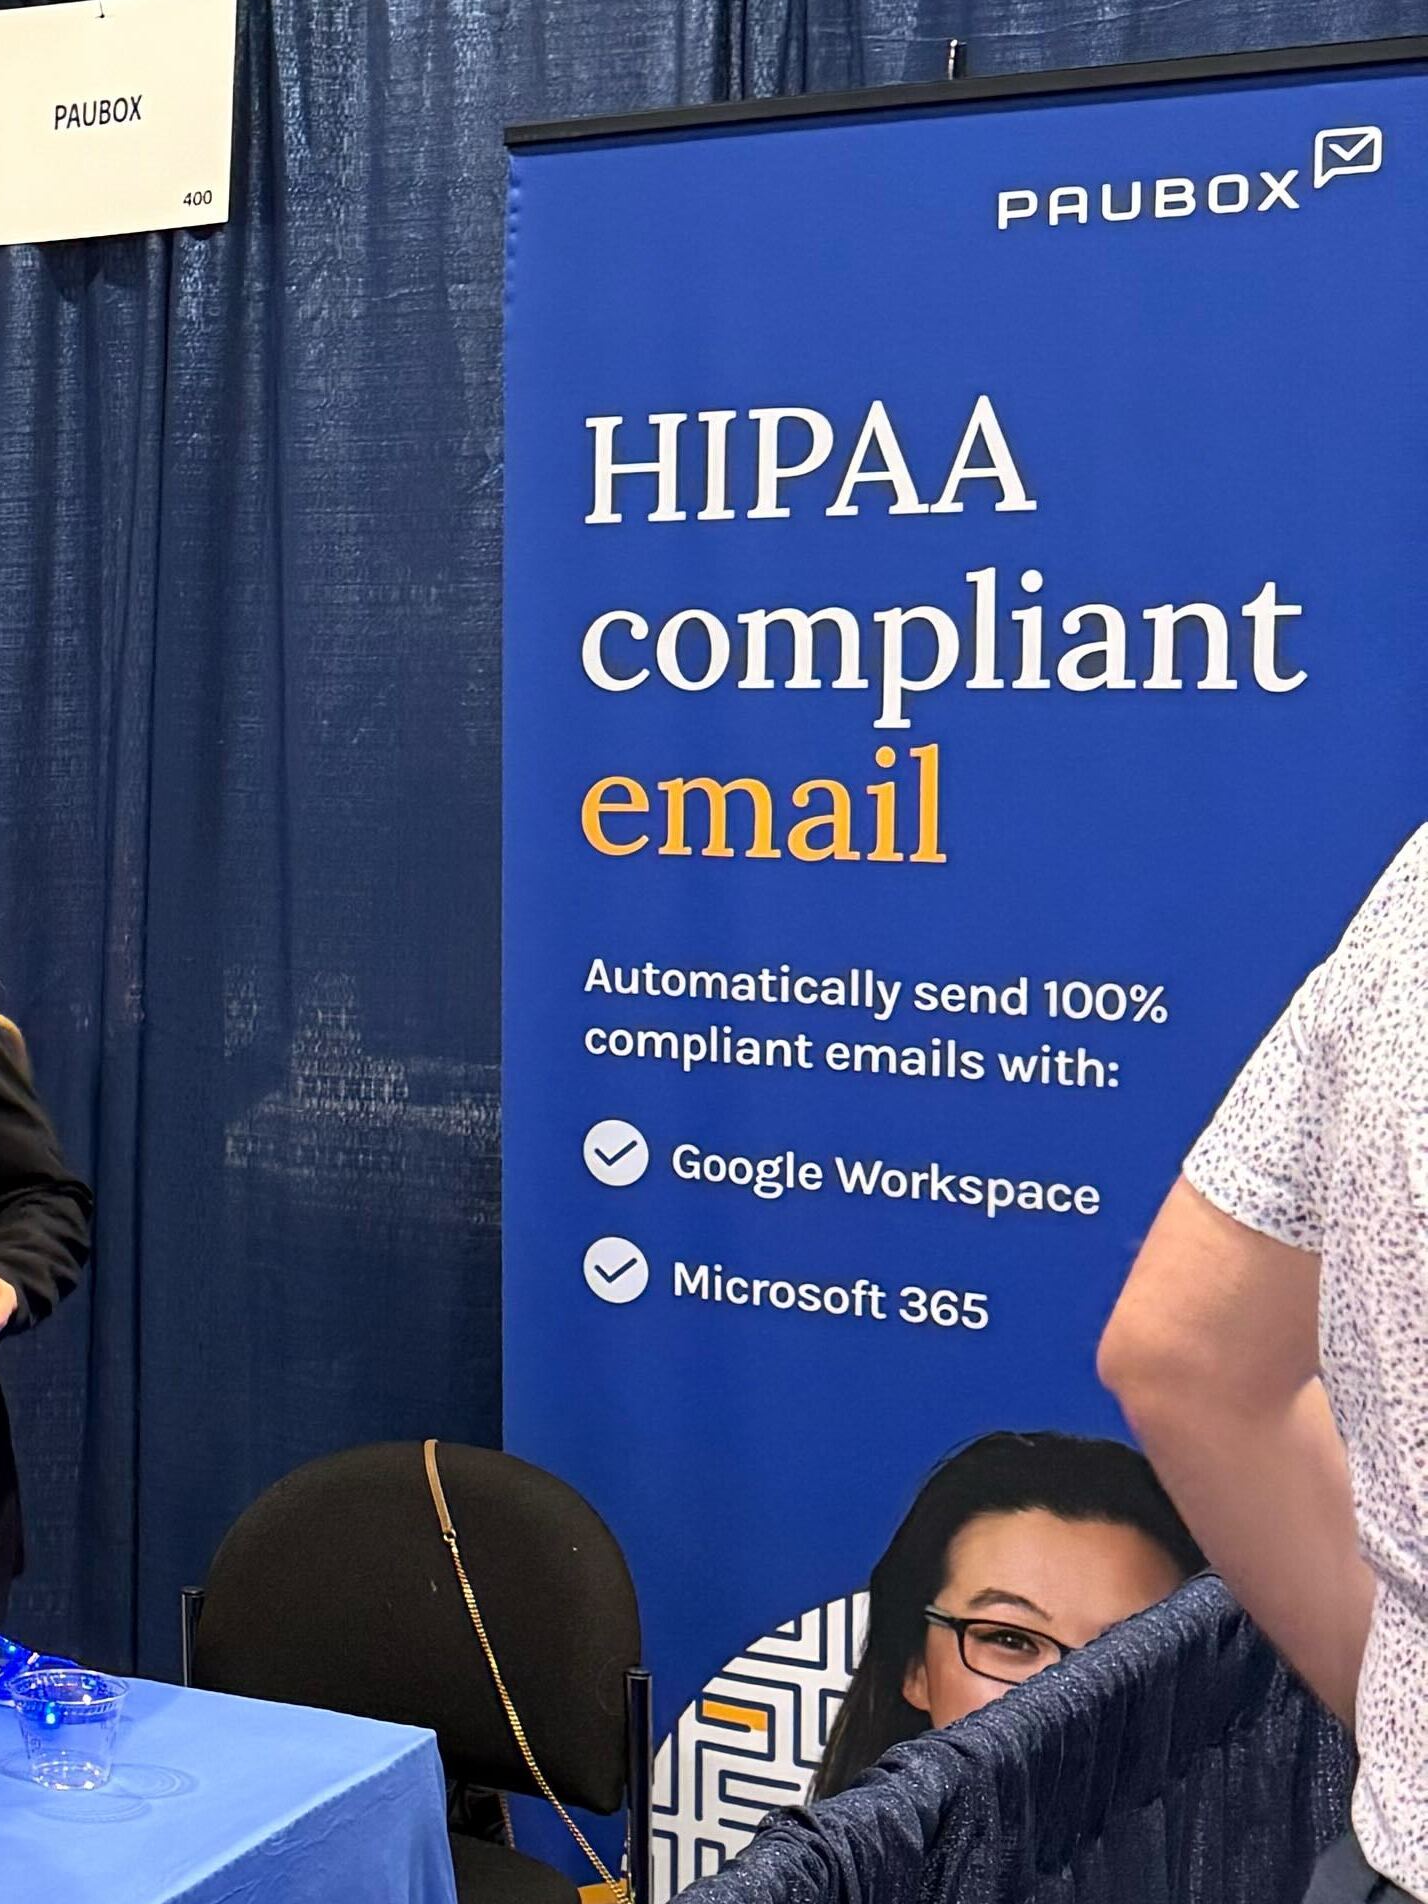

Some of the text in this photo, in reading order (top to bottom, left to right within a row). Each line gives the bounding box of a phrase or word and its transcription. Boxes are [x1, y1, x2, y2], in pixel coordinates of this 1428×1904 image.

[55, 95, 142, 130] PAUBOX
[182, 190, 213, 206] 400
[998, 170, 1299, 229] PAUBOX
[585, 395, 1037, 524] HIPAA
[582, 567, 1307, 728] compliant
[582, 744, 946, 863] email
[585, 959, 1167, 1023] Automatically send 100%
[585, 1026, 1118, 1087] compliant emails with:
[673, 1144, 1099, 1217] Google Workspace
[675, 1262, 988, 1329] Microsoft 365
